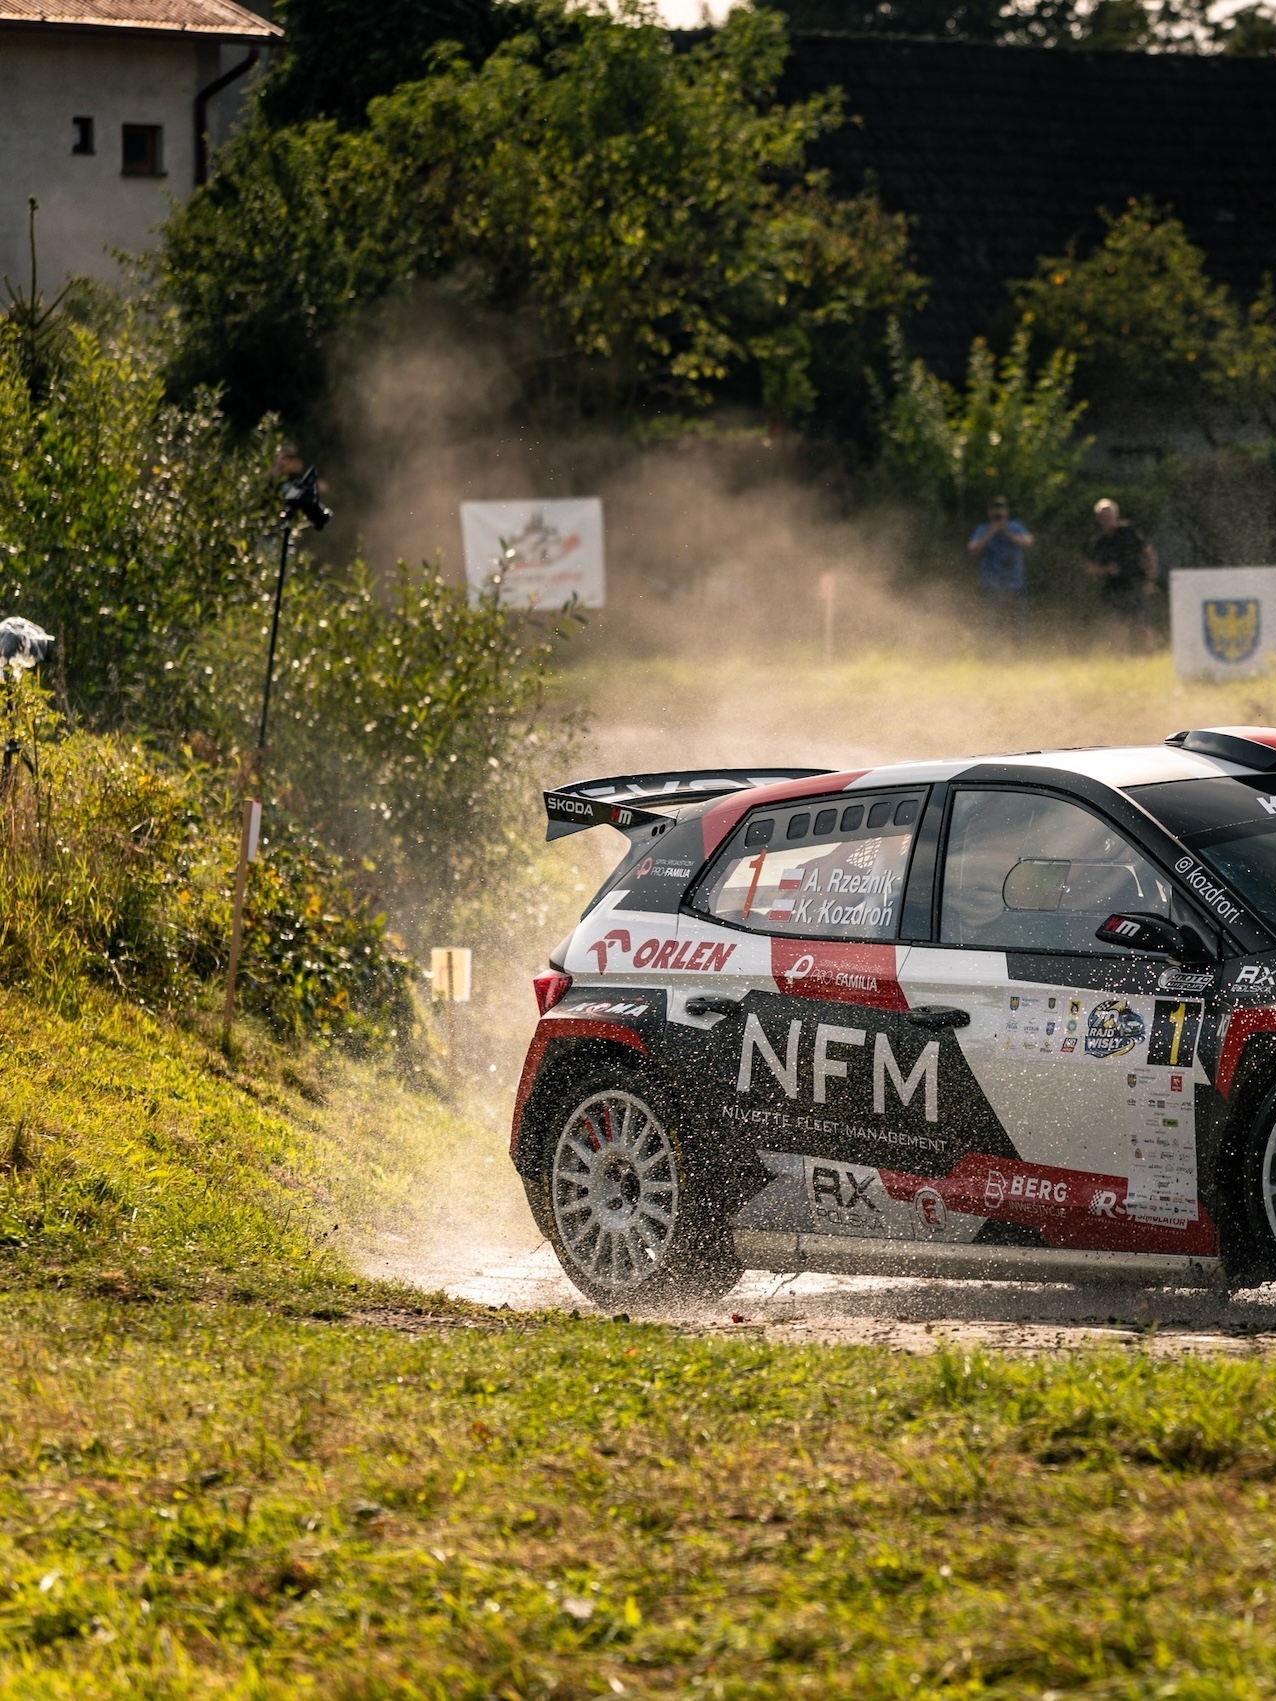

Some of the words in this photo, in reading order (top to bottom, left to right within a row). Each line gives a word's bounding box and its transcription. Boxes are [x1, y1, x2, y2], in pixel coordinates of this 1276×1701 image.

[741, 849, 767, 919] 1
[804, 868, 821, 892] A.
[827, 868, 896, 894] Rzeźnik
[795, 899, 813, 924] K.
[817, 899, 894, 926] Kozdroń
[633, 939, 738, 971] ORLEN
[1089, 1027, 1115, 1038] RAJD
[1169, 1003, 1187, 1065] 1
[736, 1012, 942, 1122] NFM
[721, 1106, 793, 1128] NIVETTE
[797, 1115, 840, 1134] FLEET
[846, 1125, 948, 1151] MANAGEMENT
[813, 1166, 882, 1212] RX
[1010, 1175, 1068, 1203] BERG
[1008, 1202, 1067, 1218] INWESTYCJE
